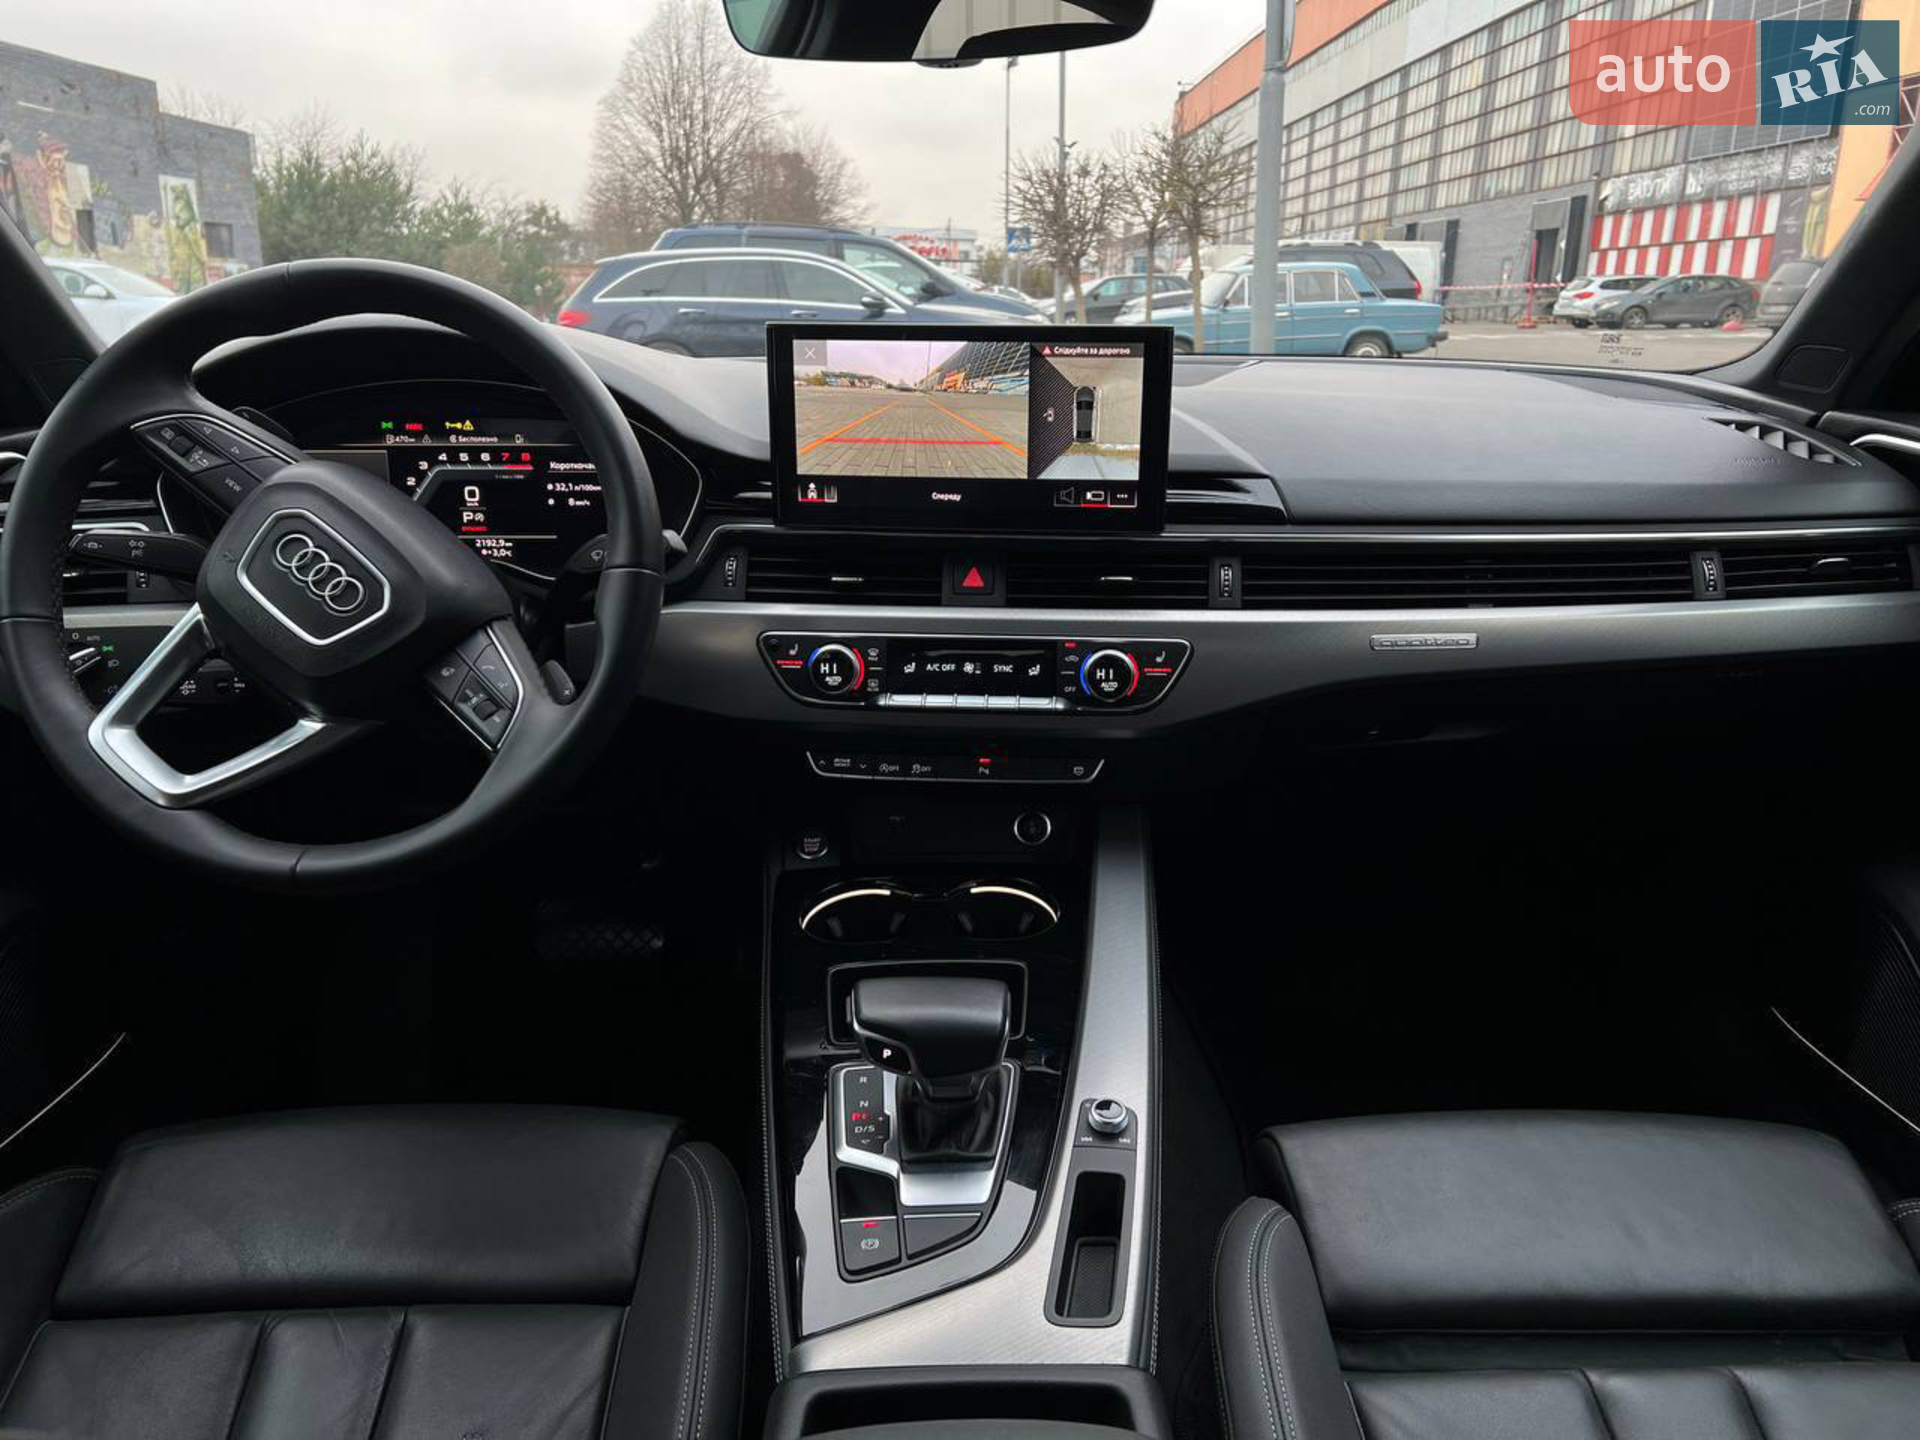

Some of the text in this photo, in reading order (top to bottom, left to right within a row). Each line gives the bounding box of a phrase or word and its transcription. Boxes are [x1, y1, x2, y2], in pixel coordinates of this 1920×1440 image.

[1099, 347, 1131, 355] дорогою
[438, 452, 448, 461] 4
[459, 452, 469, 461] 5
[502, 452, 510, 461] 7
[418, 461, 428, 470] 3
[406, 476, 416, 486] 2
[464, 486, 480, 502] 0
[1379, 637, 1470, 649] quattro
[926, 663, 956, 671] A/C OFF
[993, 664, 1014, 673] SYNC
[883, 1048, 892, 1059] P
[854, 1125, 876, 1134] D/S
